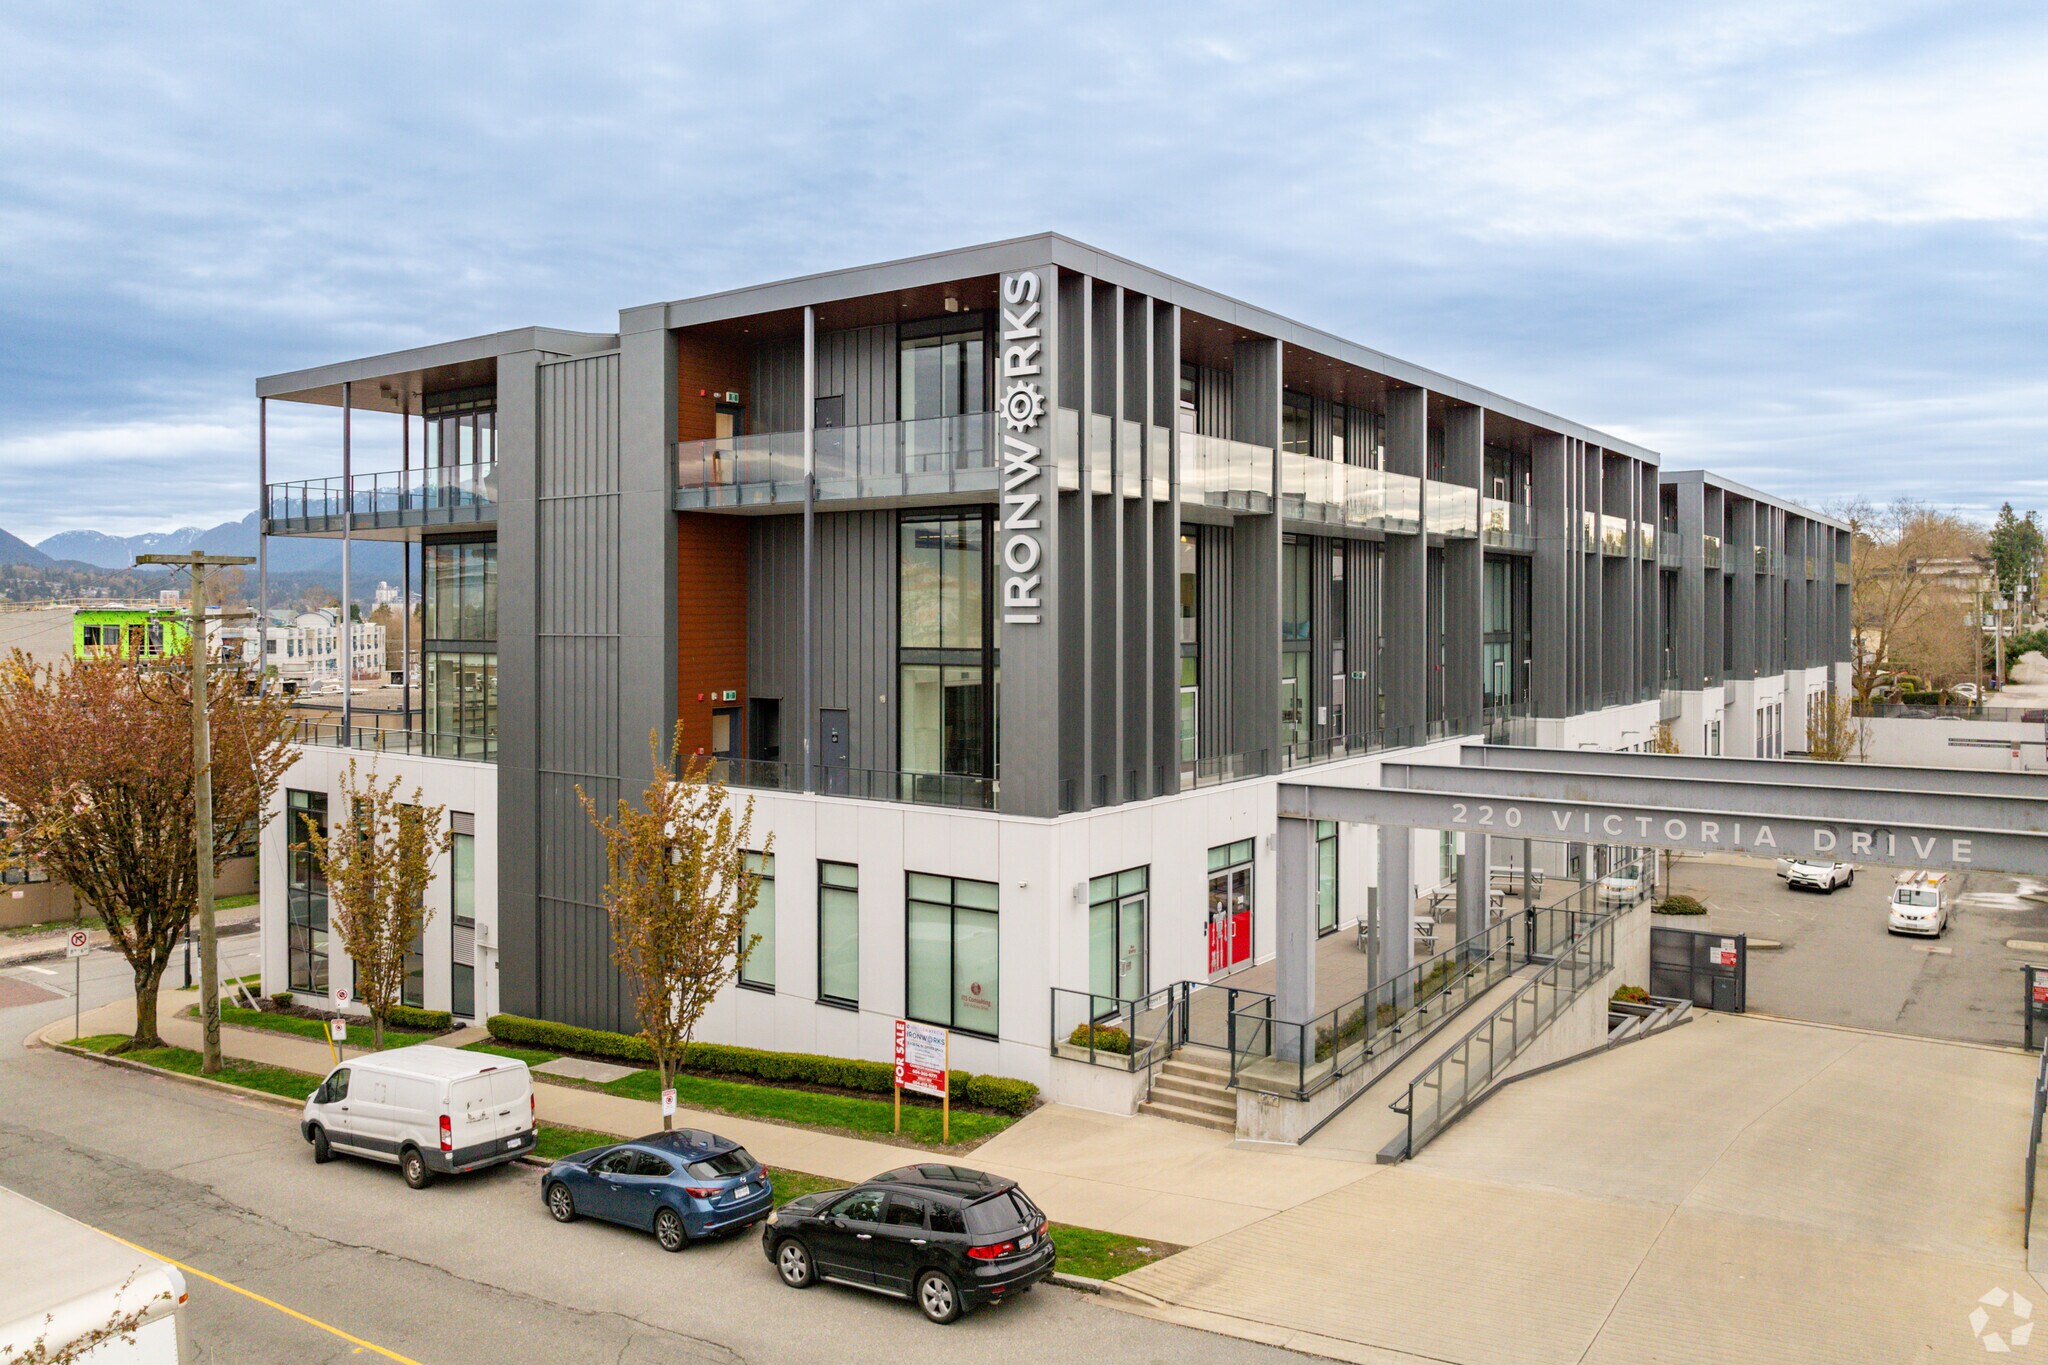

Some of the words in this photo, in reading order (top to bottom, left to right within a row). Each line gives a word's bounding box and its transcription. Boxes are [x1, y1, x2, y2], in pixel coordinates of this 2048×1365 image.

[1452, 804, 1522, 828] 220
[1552, 811, 1777, 848] VICTORIA
[1813, 829, 1972, 863] DRIVE
[895, 1023, 905, 1055] SALE
[895, 1057, 905, 1085] FOR
